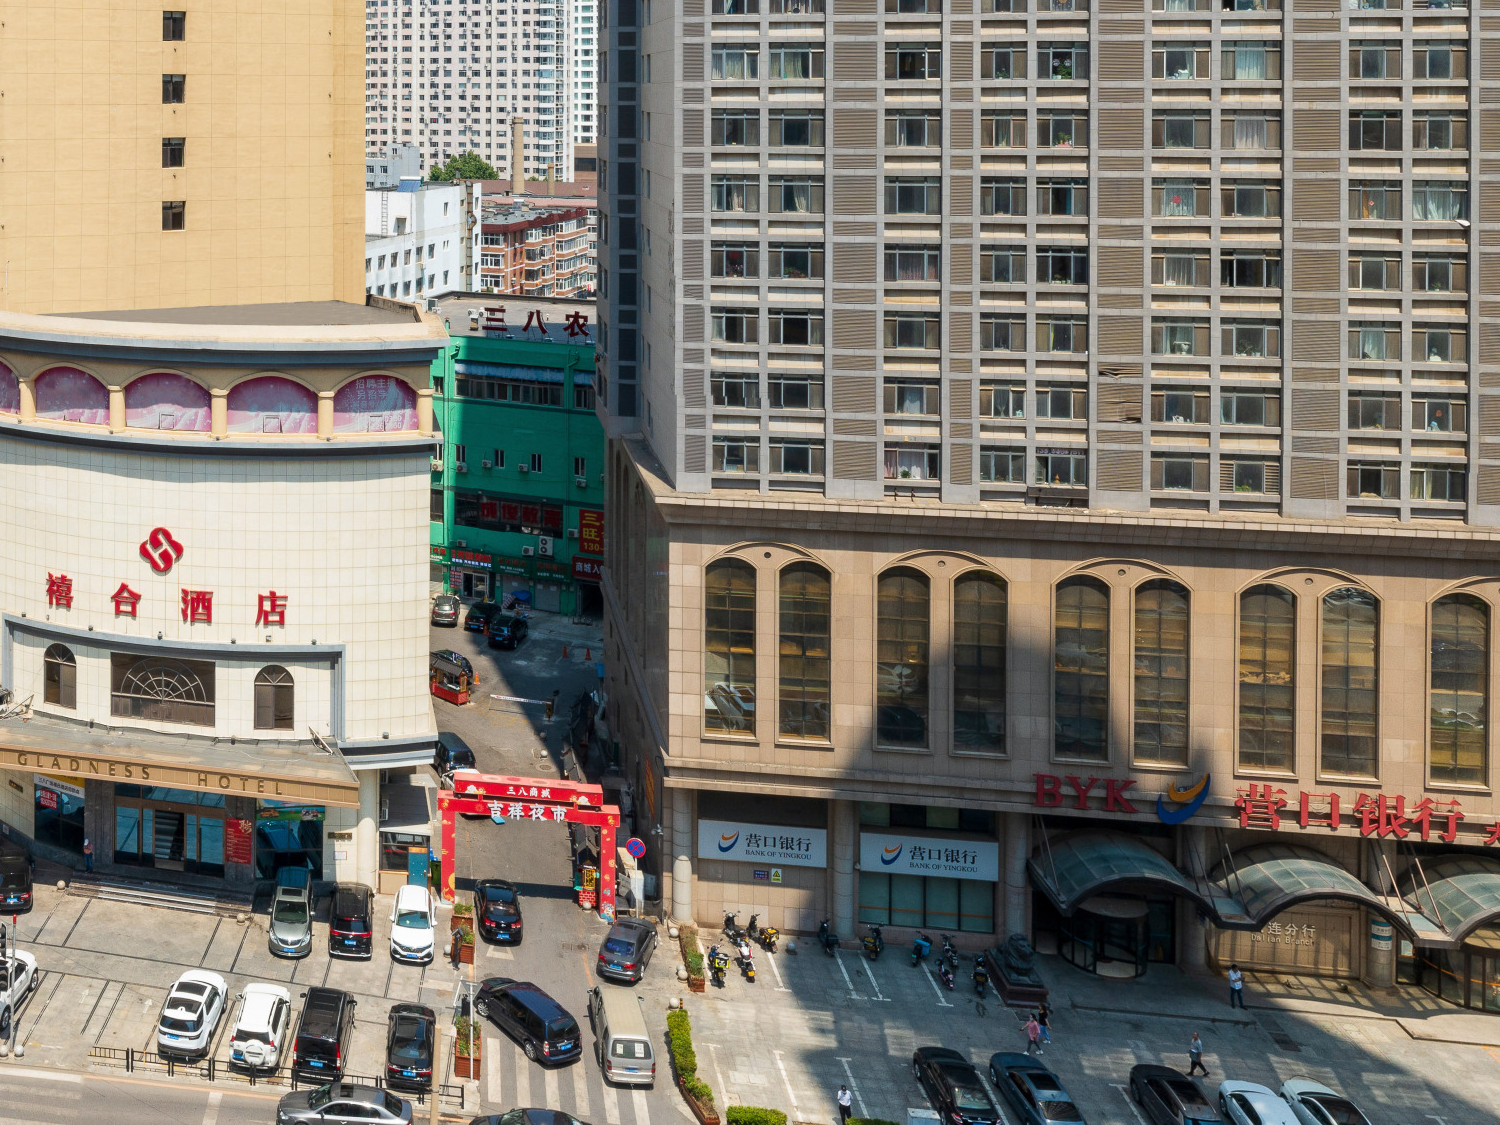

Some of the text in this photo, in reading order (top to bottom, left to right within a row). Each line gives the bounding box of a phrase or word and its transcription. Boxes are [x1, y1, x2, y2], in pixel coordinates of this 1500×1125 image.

[46, 571, 288, 626] 禧合酒店
[17, 753, 282, 795] GLADNESS HOTEL
[506, 786, 551, 799] 三八商城
[1032, 773, 1140, 813] BYK
[488, 800, 568, 823] 吉祥夜市
[1235, 783, 1466, 843] 营口银行
[745, 833, 812, 852] 营口银行
[745, 849, 766, 857] BANK
[778, 851, 812, 861] YINGKOU
[909, 845, 978, 865] 营口银行
[909, 861, 930, 869] BANK
[944, 865, 978, 873] YINGKOU
[1261, 921, 1316, 938] 连分行
[1251, 933, 1315, 947] Dalian Branch
